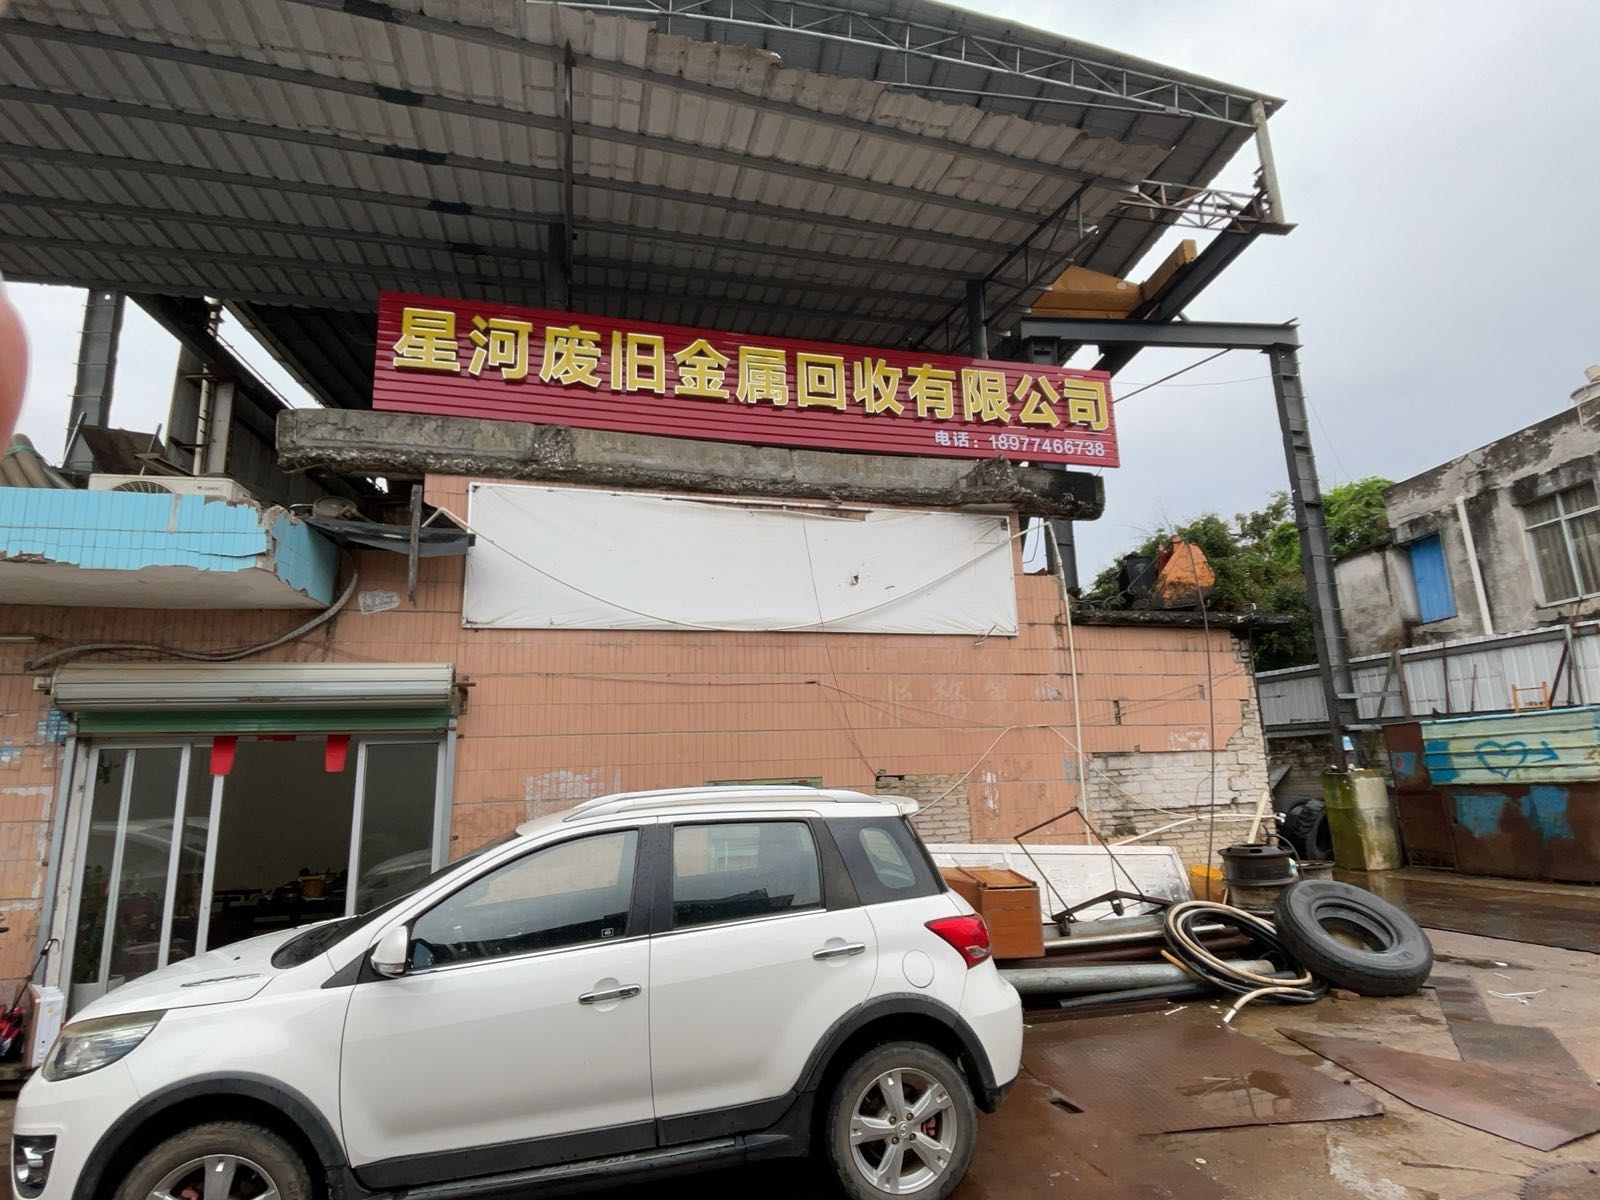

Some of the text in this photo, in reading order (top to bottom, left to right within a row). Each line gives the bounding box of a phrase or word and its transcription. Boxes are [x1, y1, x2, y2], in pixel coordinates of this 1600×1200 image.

[392, 306, 1110, 432] 星河废旧金属回收有限公司
